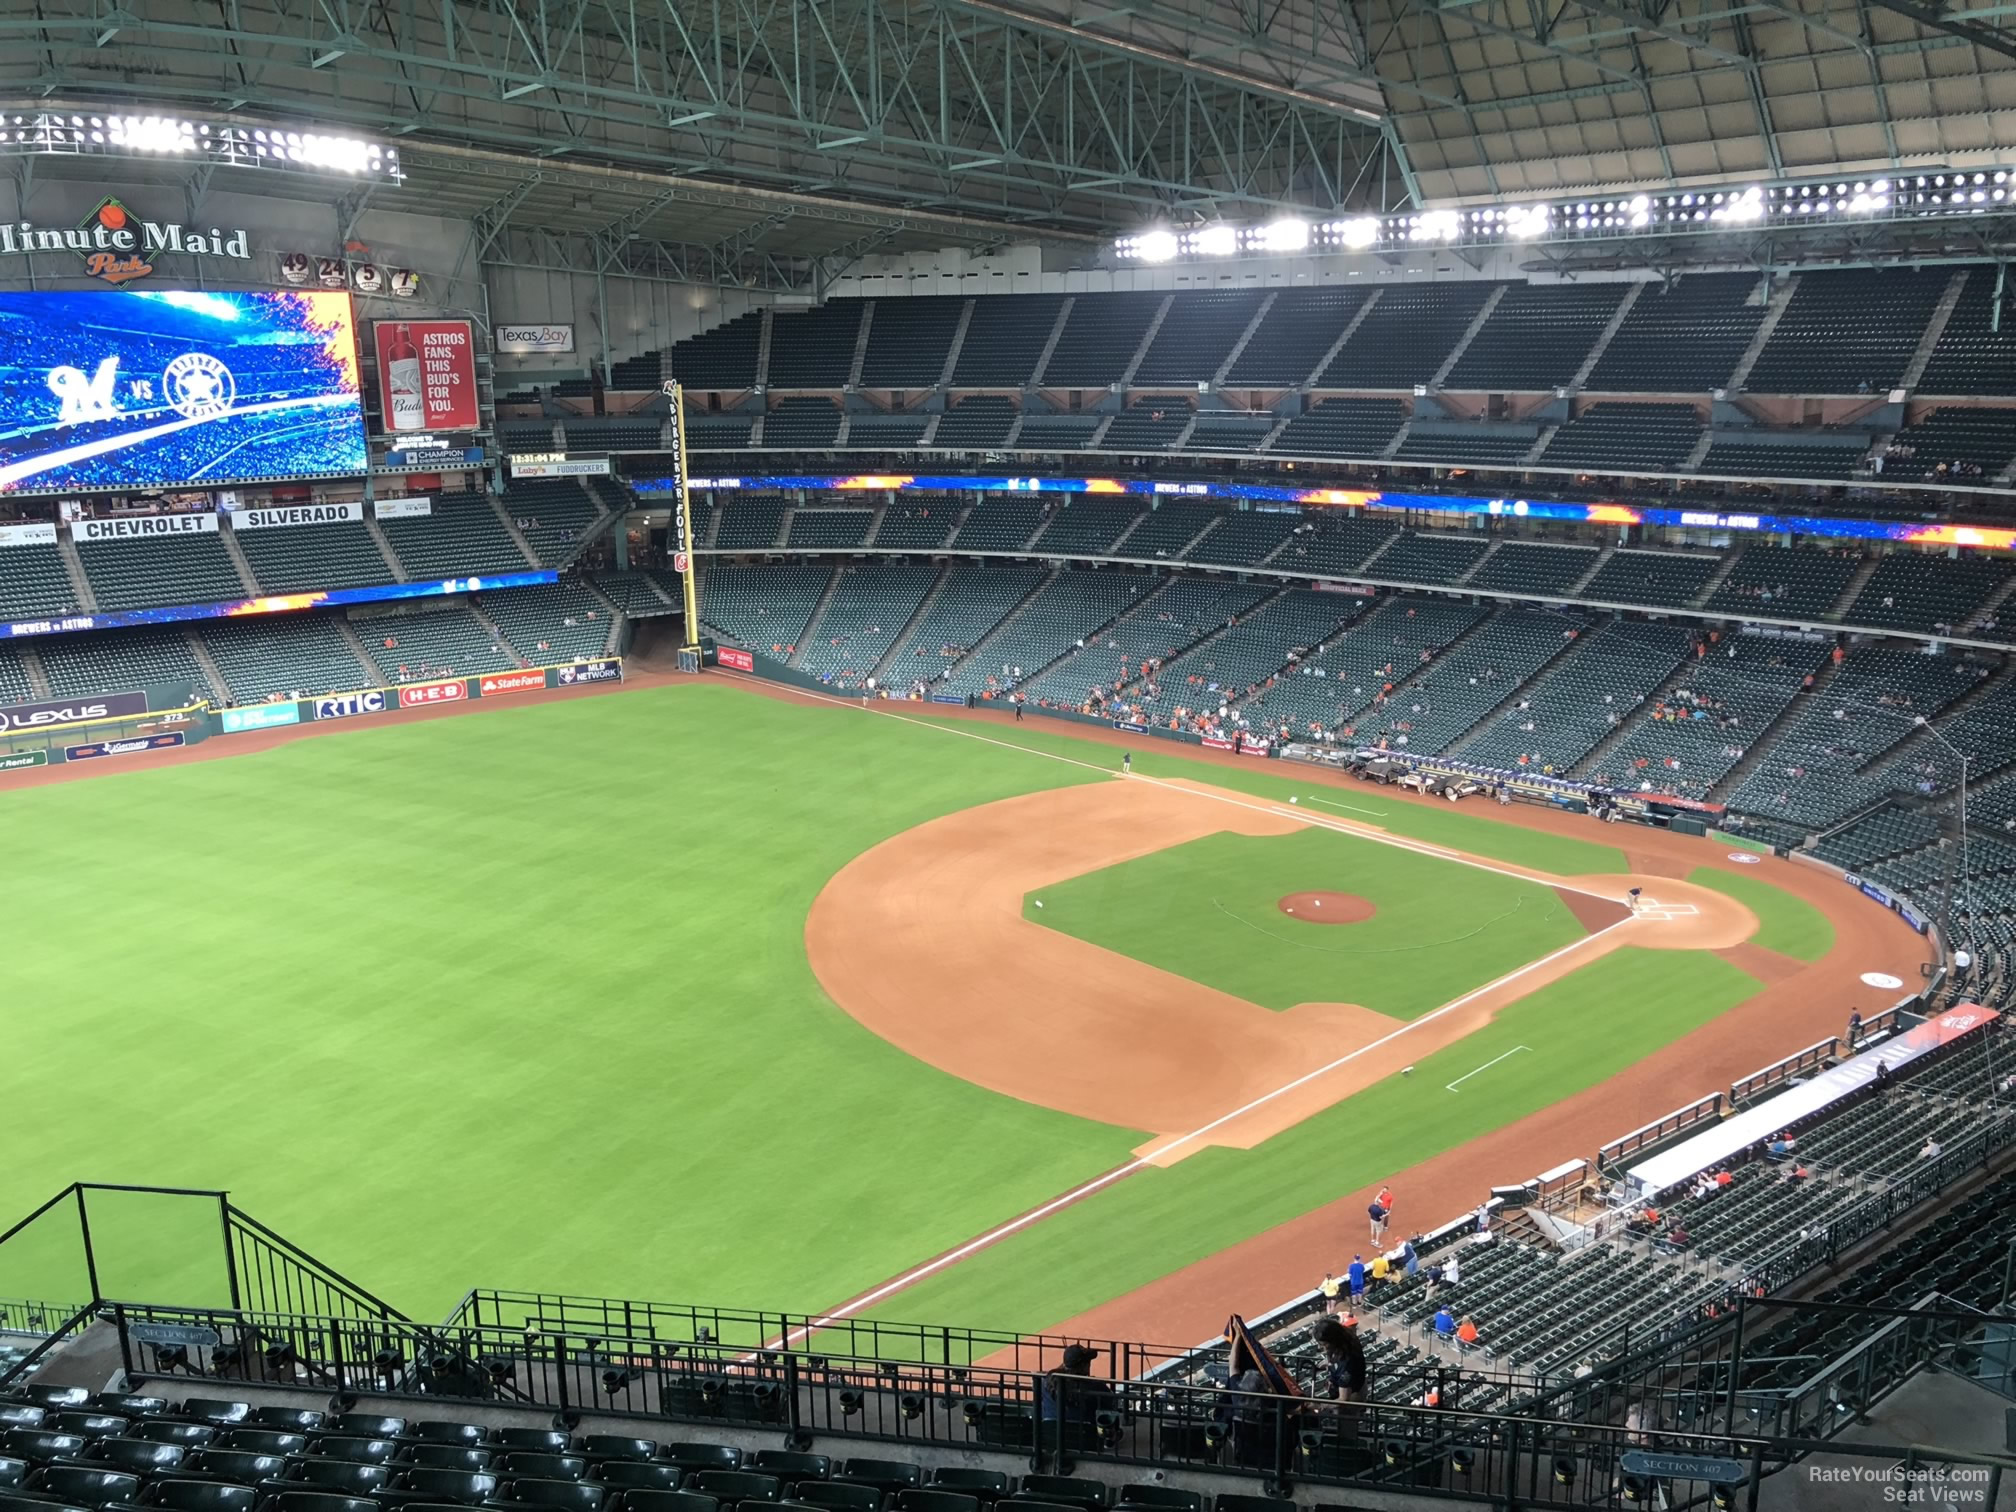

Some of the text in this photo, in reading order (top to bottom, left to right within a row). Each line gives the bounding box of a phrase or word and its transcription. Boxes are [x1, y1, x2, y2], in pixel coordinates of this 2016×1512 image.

[144, 222, 251, 259] Maid
[86, 252, 147, 277] Park
[283, 253, 308, 272] 49
[320, 258, 345, 276] 24
[363, 263, 375, 281] 5
[398, 269, 410, 286] 7
[423, 333, 465, 345] ASTROS
[500, 327, 569, 345] Texas Bay
[424, 346, 455, 359] FANS,
[425, 360, 450, 372] THIS
[426, 373, 460, 385] BUD'S
[131, 380, 153, 400] VS
[428, 387, 449, 399] FOR
[429, 399, 455, 412] YOU.
[418, 450, 464, 459] CHAMPION
[549, 453, 565, 461] PM
[517, 466, 546, 475] Luby's
[557, 464, 604, 473] FUDDRUCKERS
[248, 506, 349, 526] SILVERADO
[86, 516, 204, 538] CHEVROLET
[676, 503, 685, 550] FOUL
[11, 621, 51, 635] BREWERS
[62, 617, 94, 630] ASTROS
[588, 662, 605, 671] MLB
[577, 670, 616, 681] NETWORK
[409, 685, 458, 701] H-E-B
[315, 692, 383, 718] RTIC
[13, 704, 108, 727] LEXUS
[164, 713, 183, 722] 373
[5, 756, 34, 767] Rental
[144, 1329, 186, 1339] SECTION
[1643, 1459, 1721, 1474] SECTION 407
